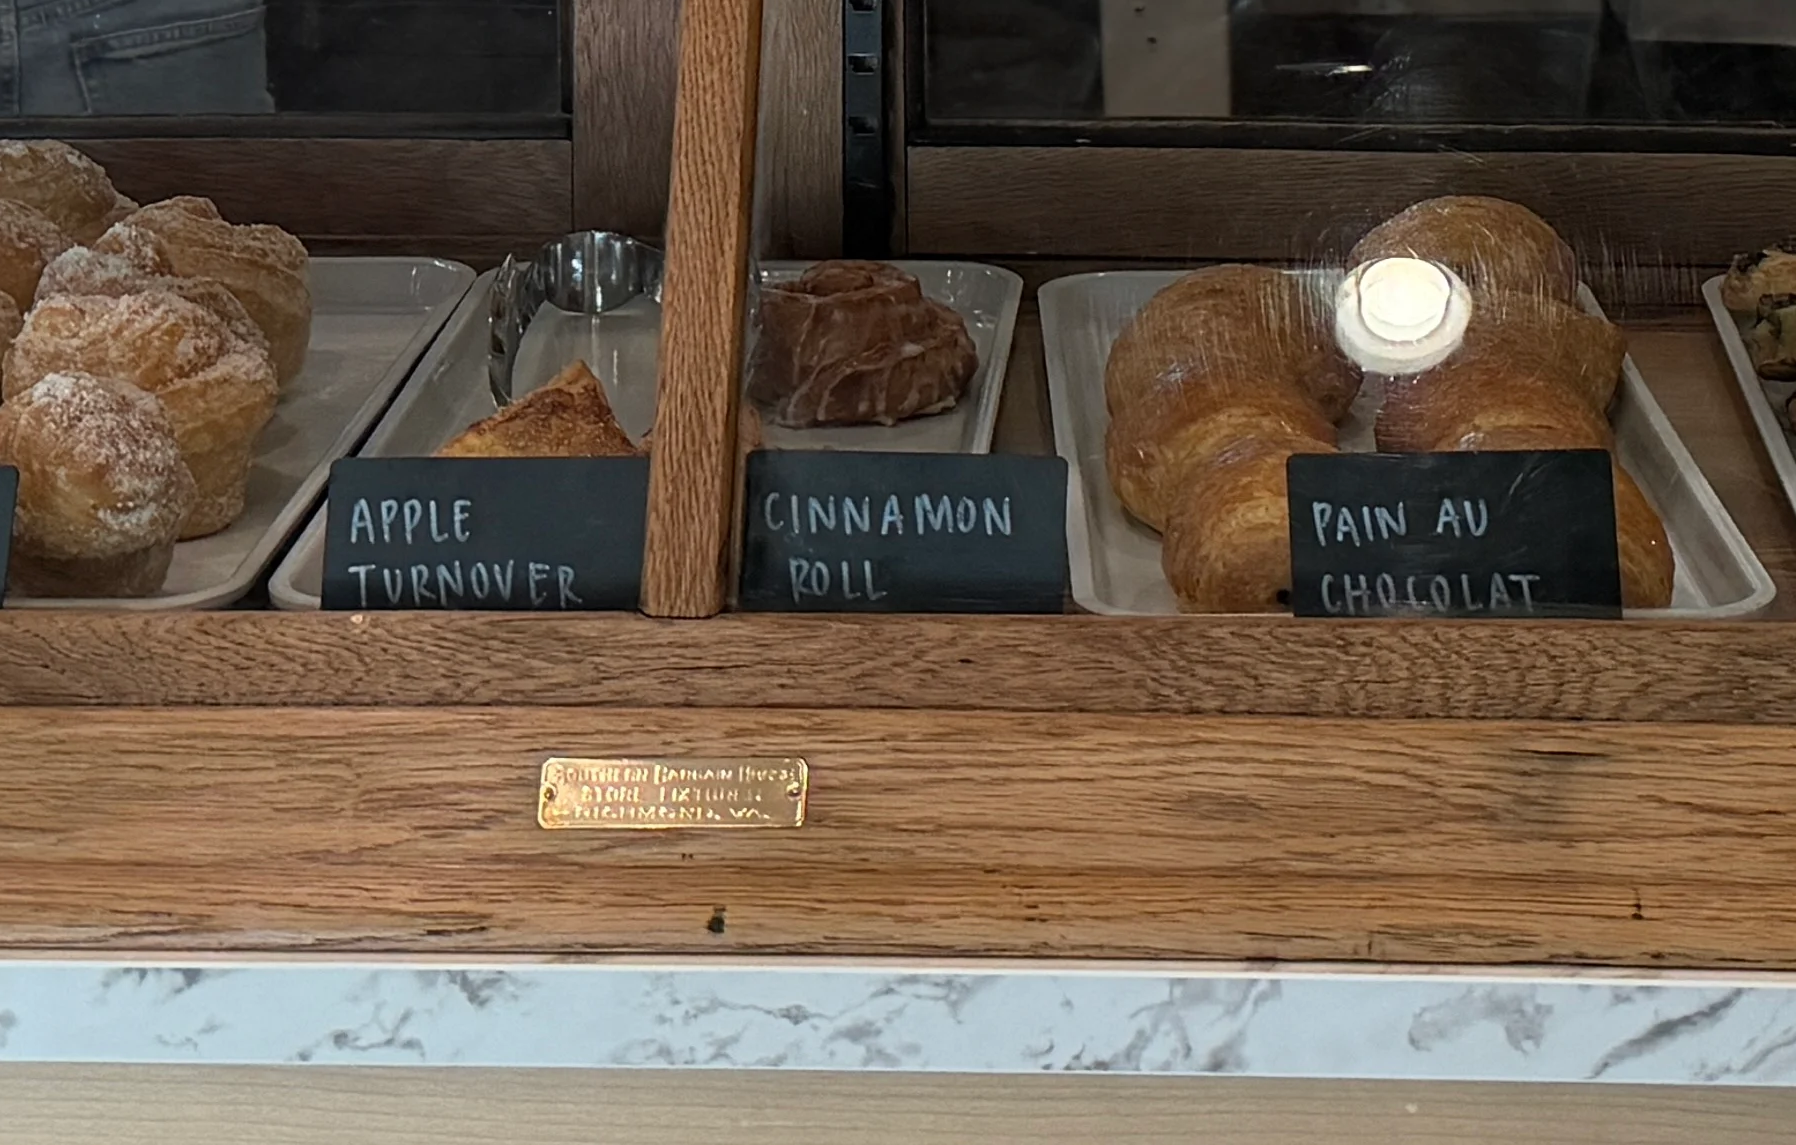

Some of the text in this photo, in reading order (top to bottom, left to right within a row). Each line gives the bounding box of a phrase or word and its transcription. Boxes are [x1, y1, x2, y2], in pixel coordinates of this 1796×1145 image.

[350, 498, 472, 545] APPLE
[764, 492, 1012, 536] CINNAMON
[1311, 498, 1490, 547] PAIN AU
[347, 559, 584, 608] TURNOVER
[788, 556, 888, 604] ROLL
[1320, 572, 1541, 613] CHOCOLAT
